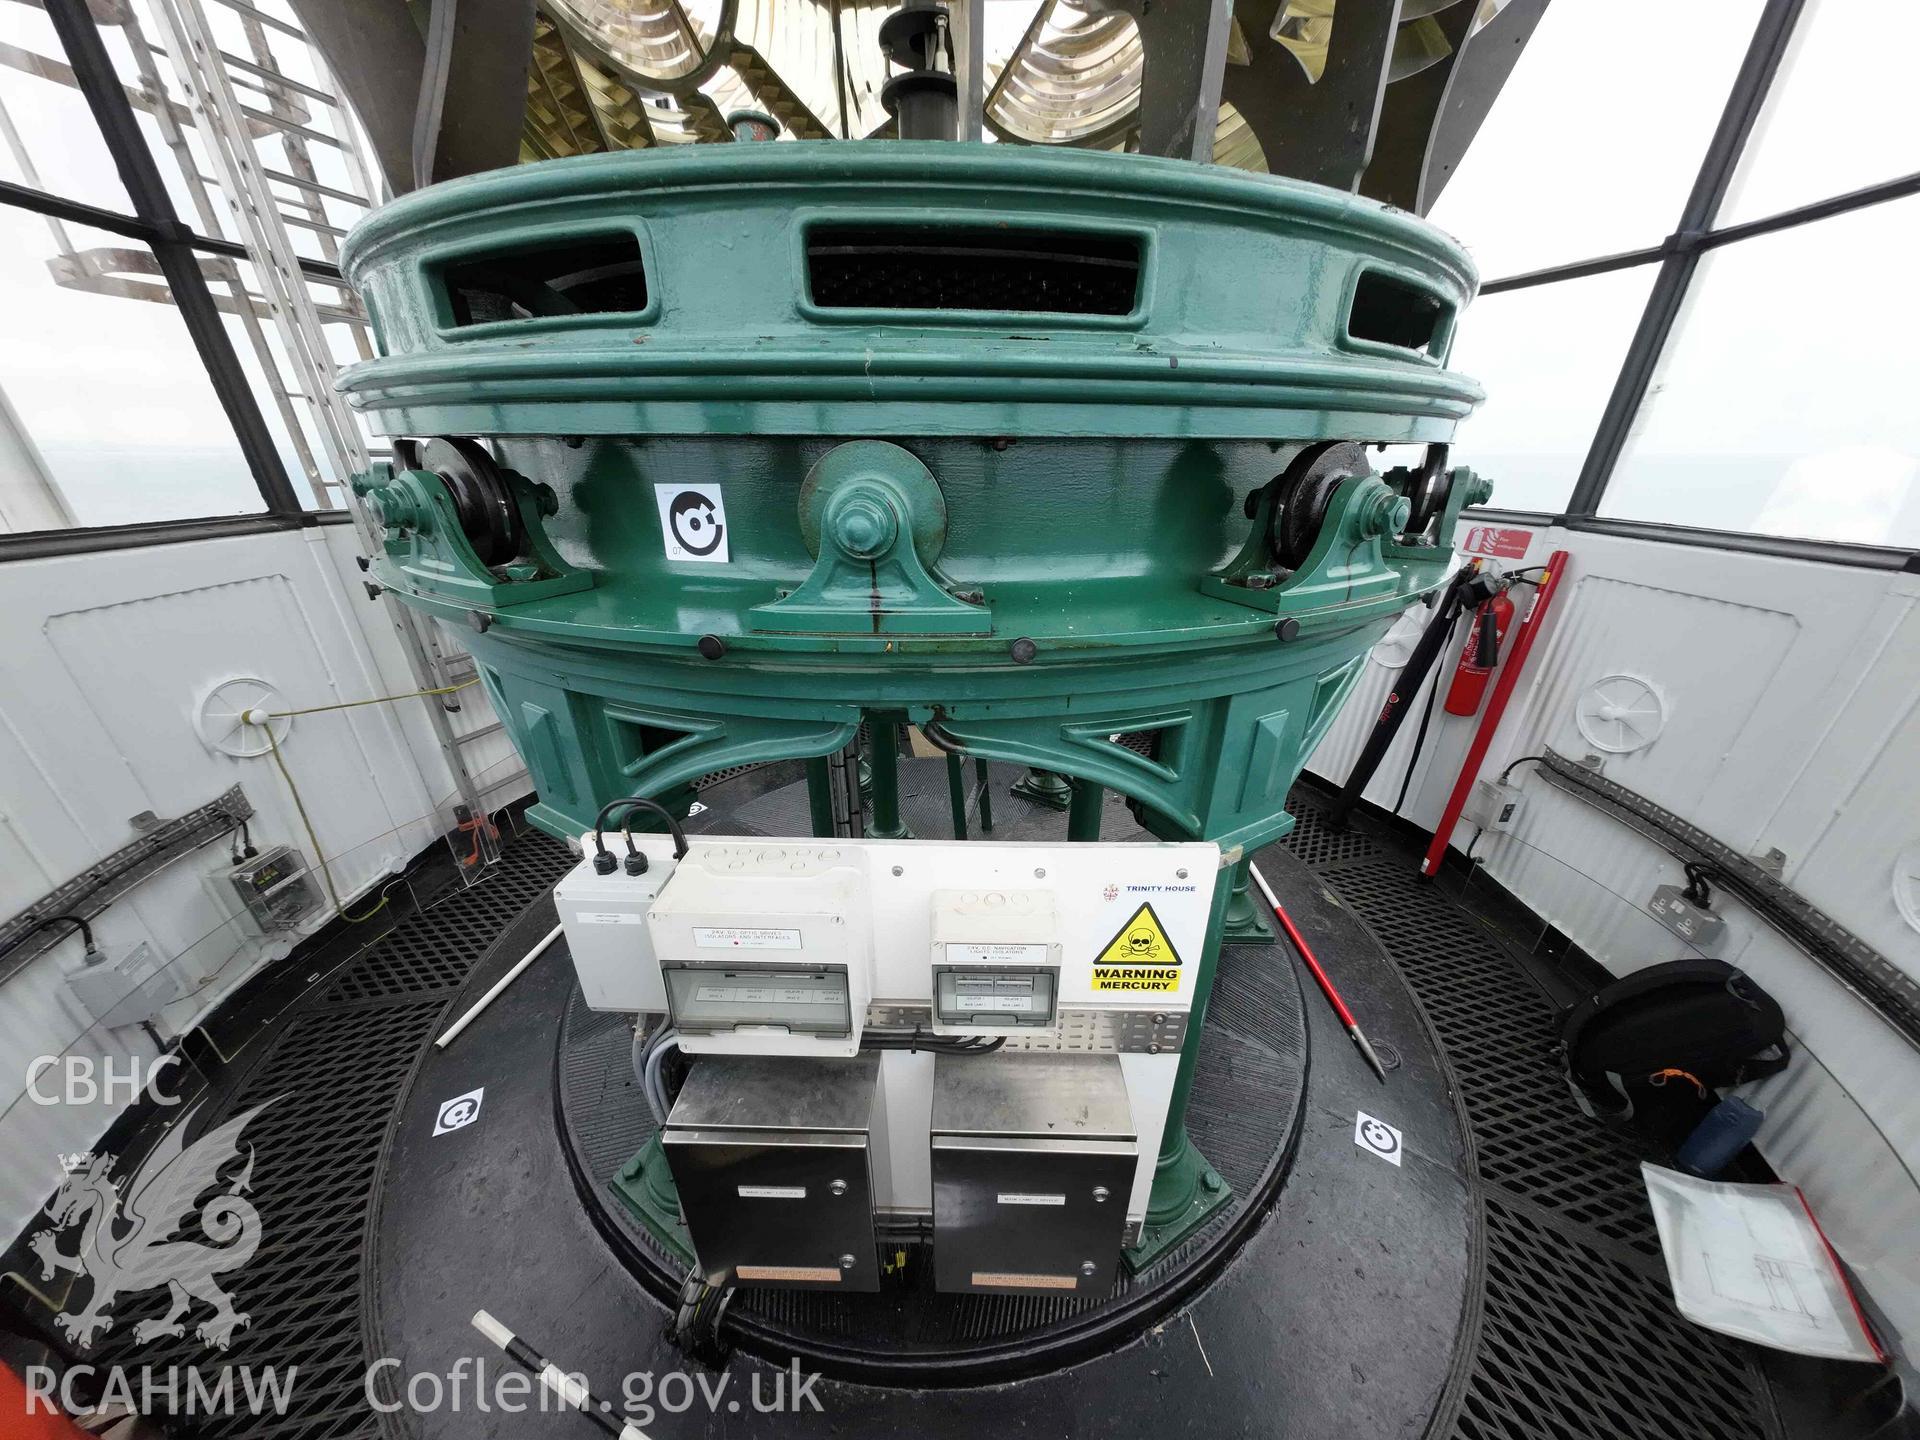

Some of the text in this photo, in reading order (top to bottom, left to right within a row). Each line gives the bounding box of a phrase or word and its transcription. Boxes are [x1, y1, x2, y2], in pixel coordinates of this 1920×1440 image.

[673, 547, 681, 555] 07
[1094, 969, 1178, 979] WARNING
[1100, 982, 1171, 990] MERCURY
